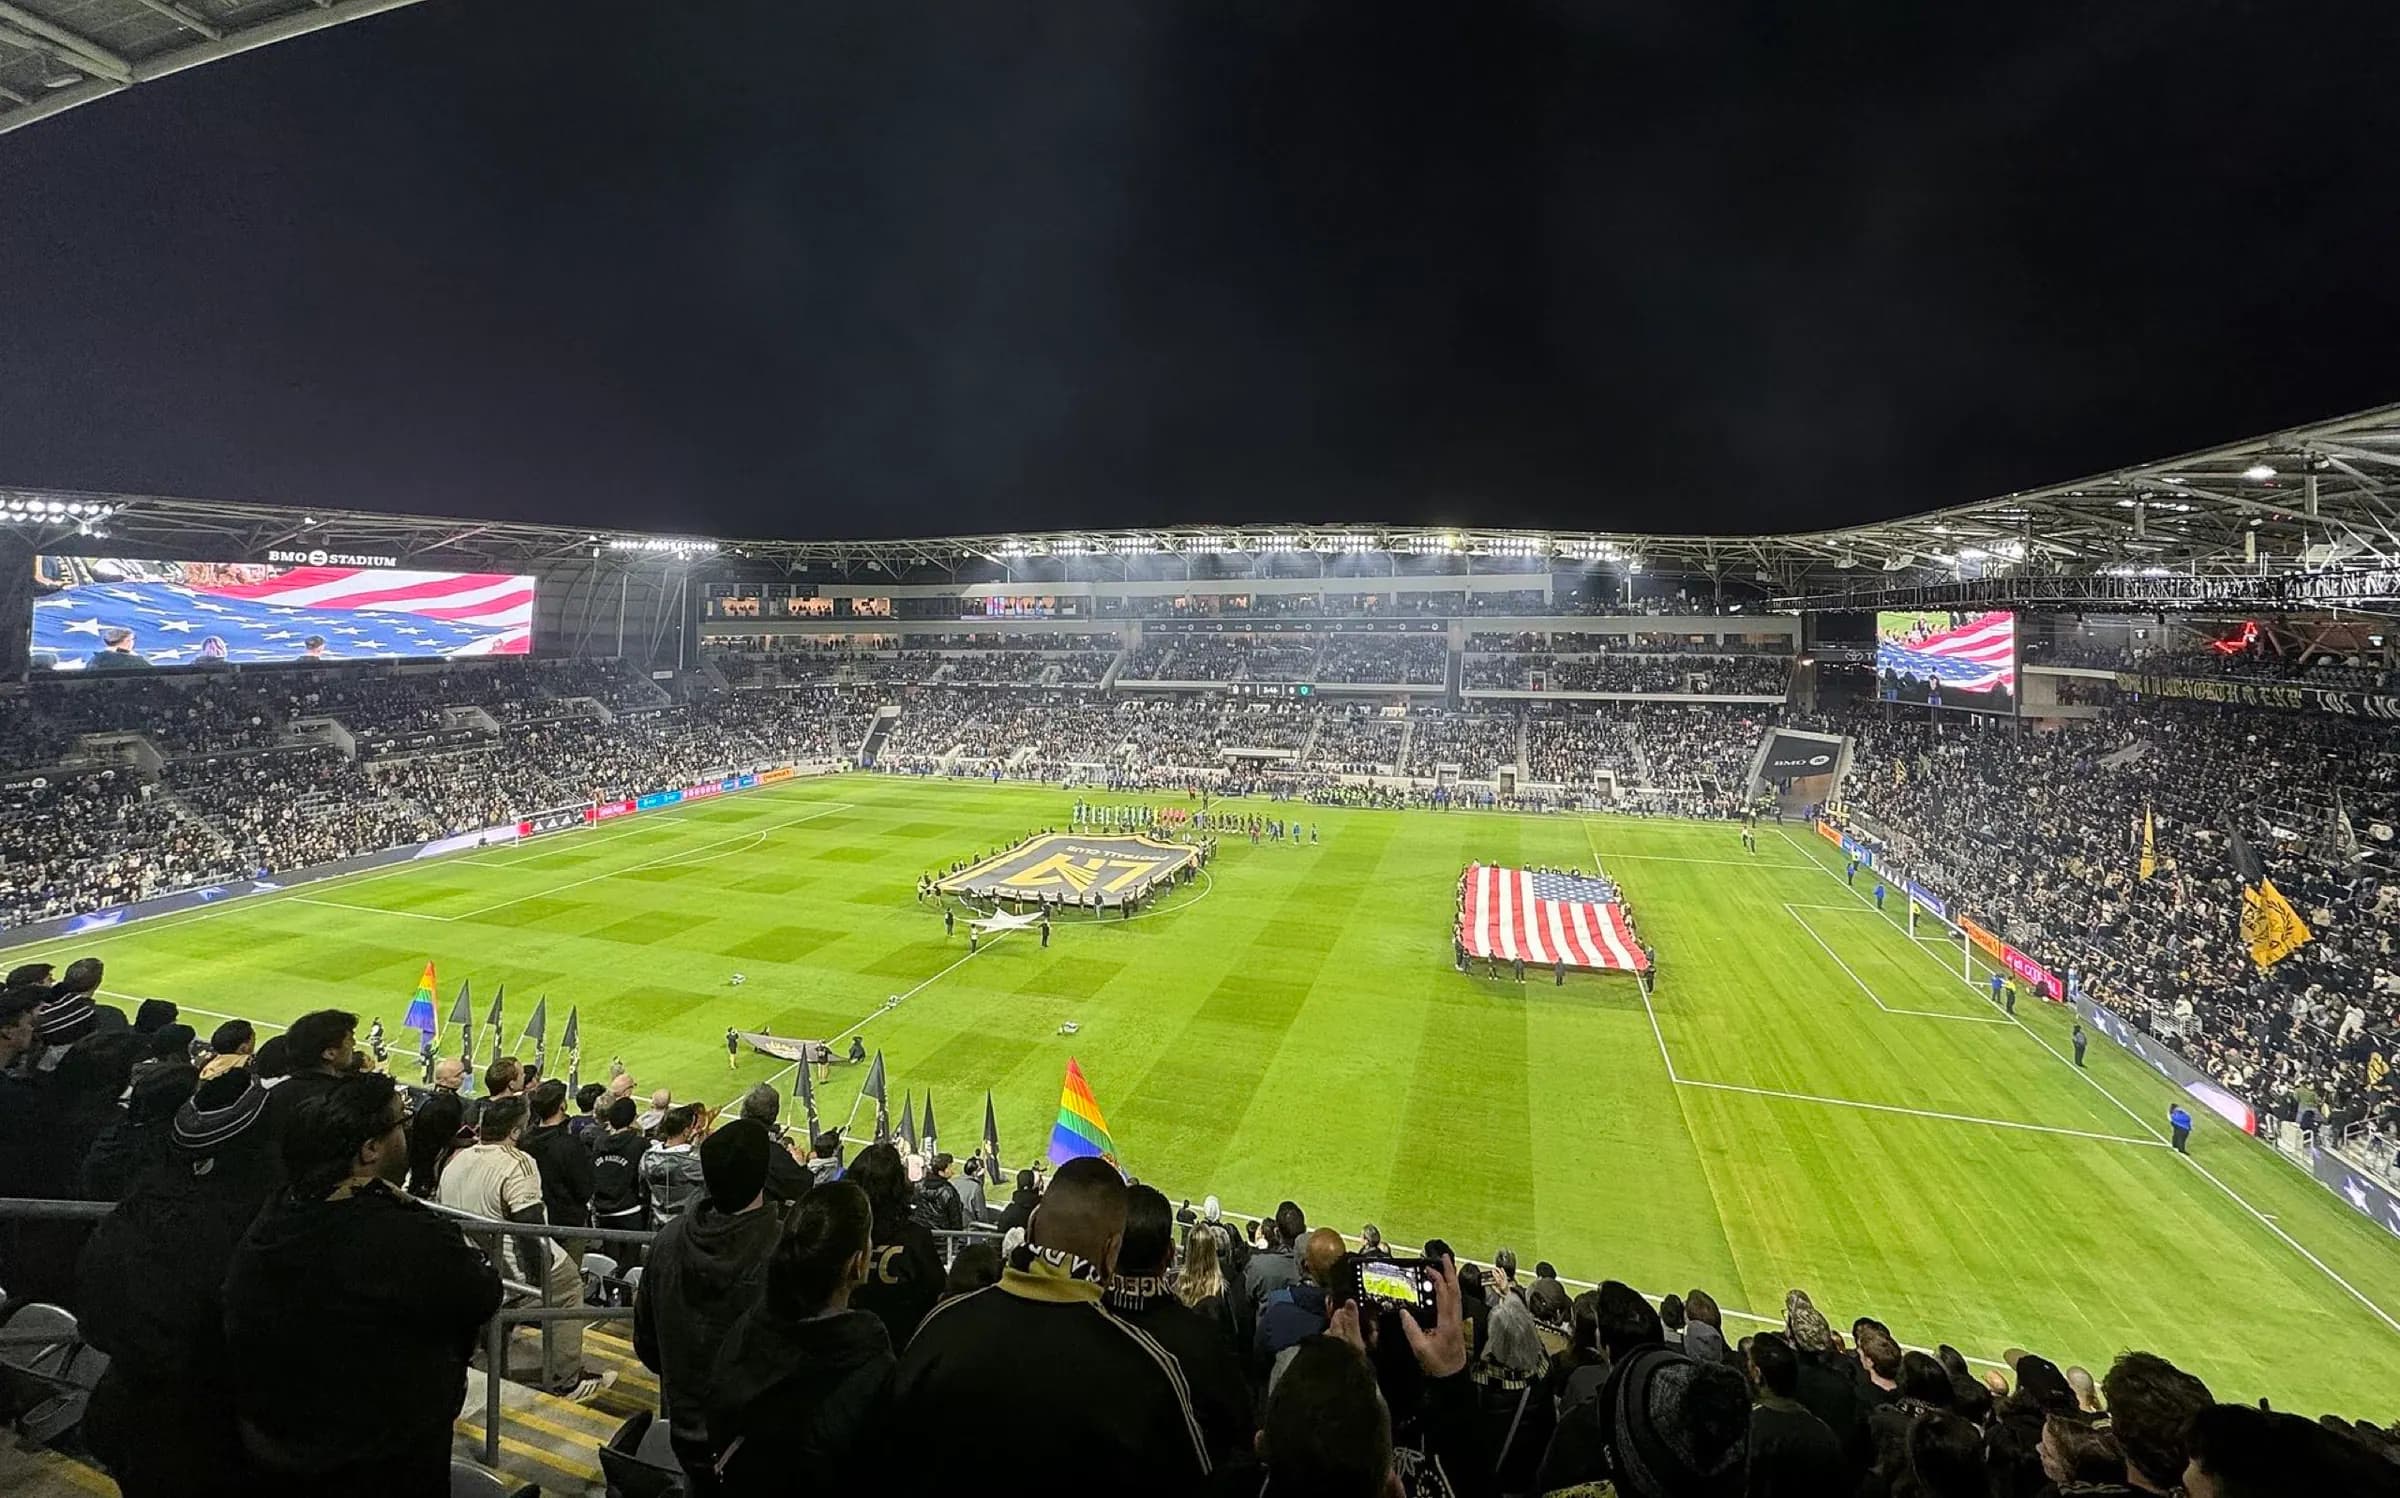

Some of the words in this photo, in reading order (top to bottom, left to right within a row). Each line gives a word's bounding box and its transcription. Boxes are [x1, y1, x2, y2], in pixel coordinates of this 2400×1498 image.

[268, 550, 307, 563] BMO
[328, 553, 397, 567] STADIUM
[1774, 759, 1806, 767] BMO
